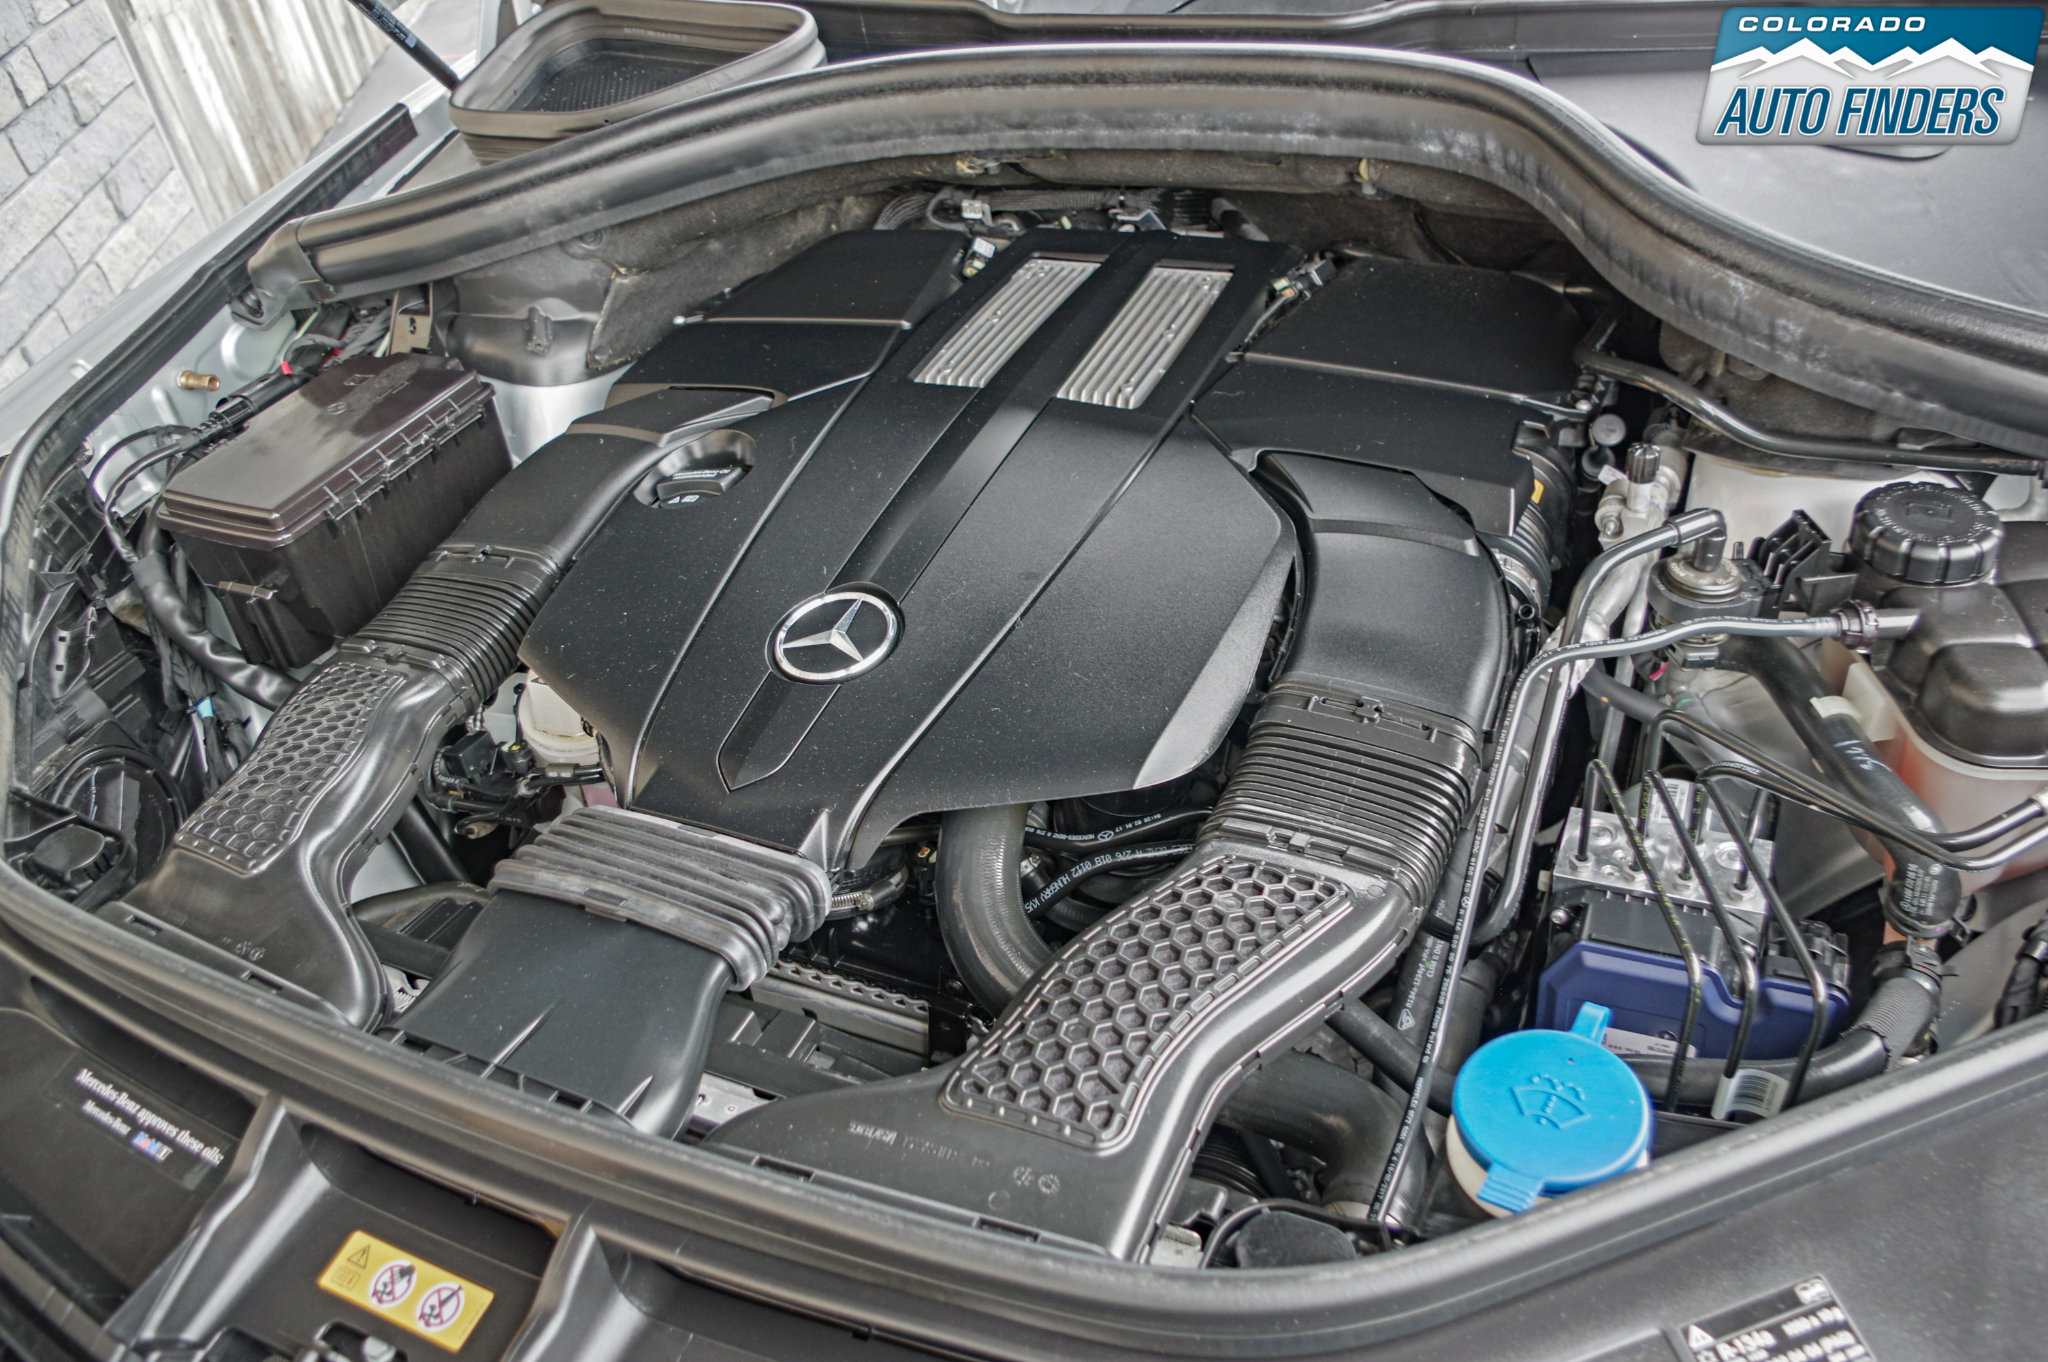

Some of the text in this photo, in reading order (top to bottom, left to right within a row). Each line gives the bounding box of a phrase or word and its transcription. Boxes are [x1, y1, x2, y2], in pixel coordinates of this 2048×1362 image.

[1094, 855, 1112, 866] 018
[1115, 850, 1132, 861] 276
[1071, 861, 1092, 878] 0112
[1040, 874, 1071, 903] HUNGARY
[1024, 899, 1040, 913] KVS
[75, 1068, 224, 1166] Mercedes-Benz approves these oils:
[82, 1100, 131, 1136] Mercedes-Benz
